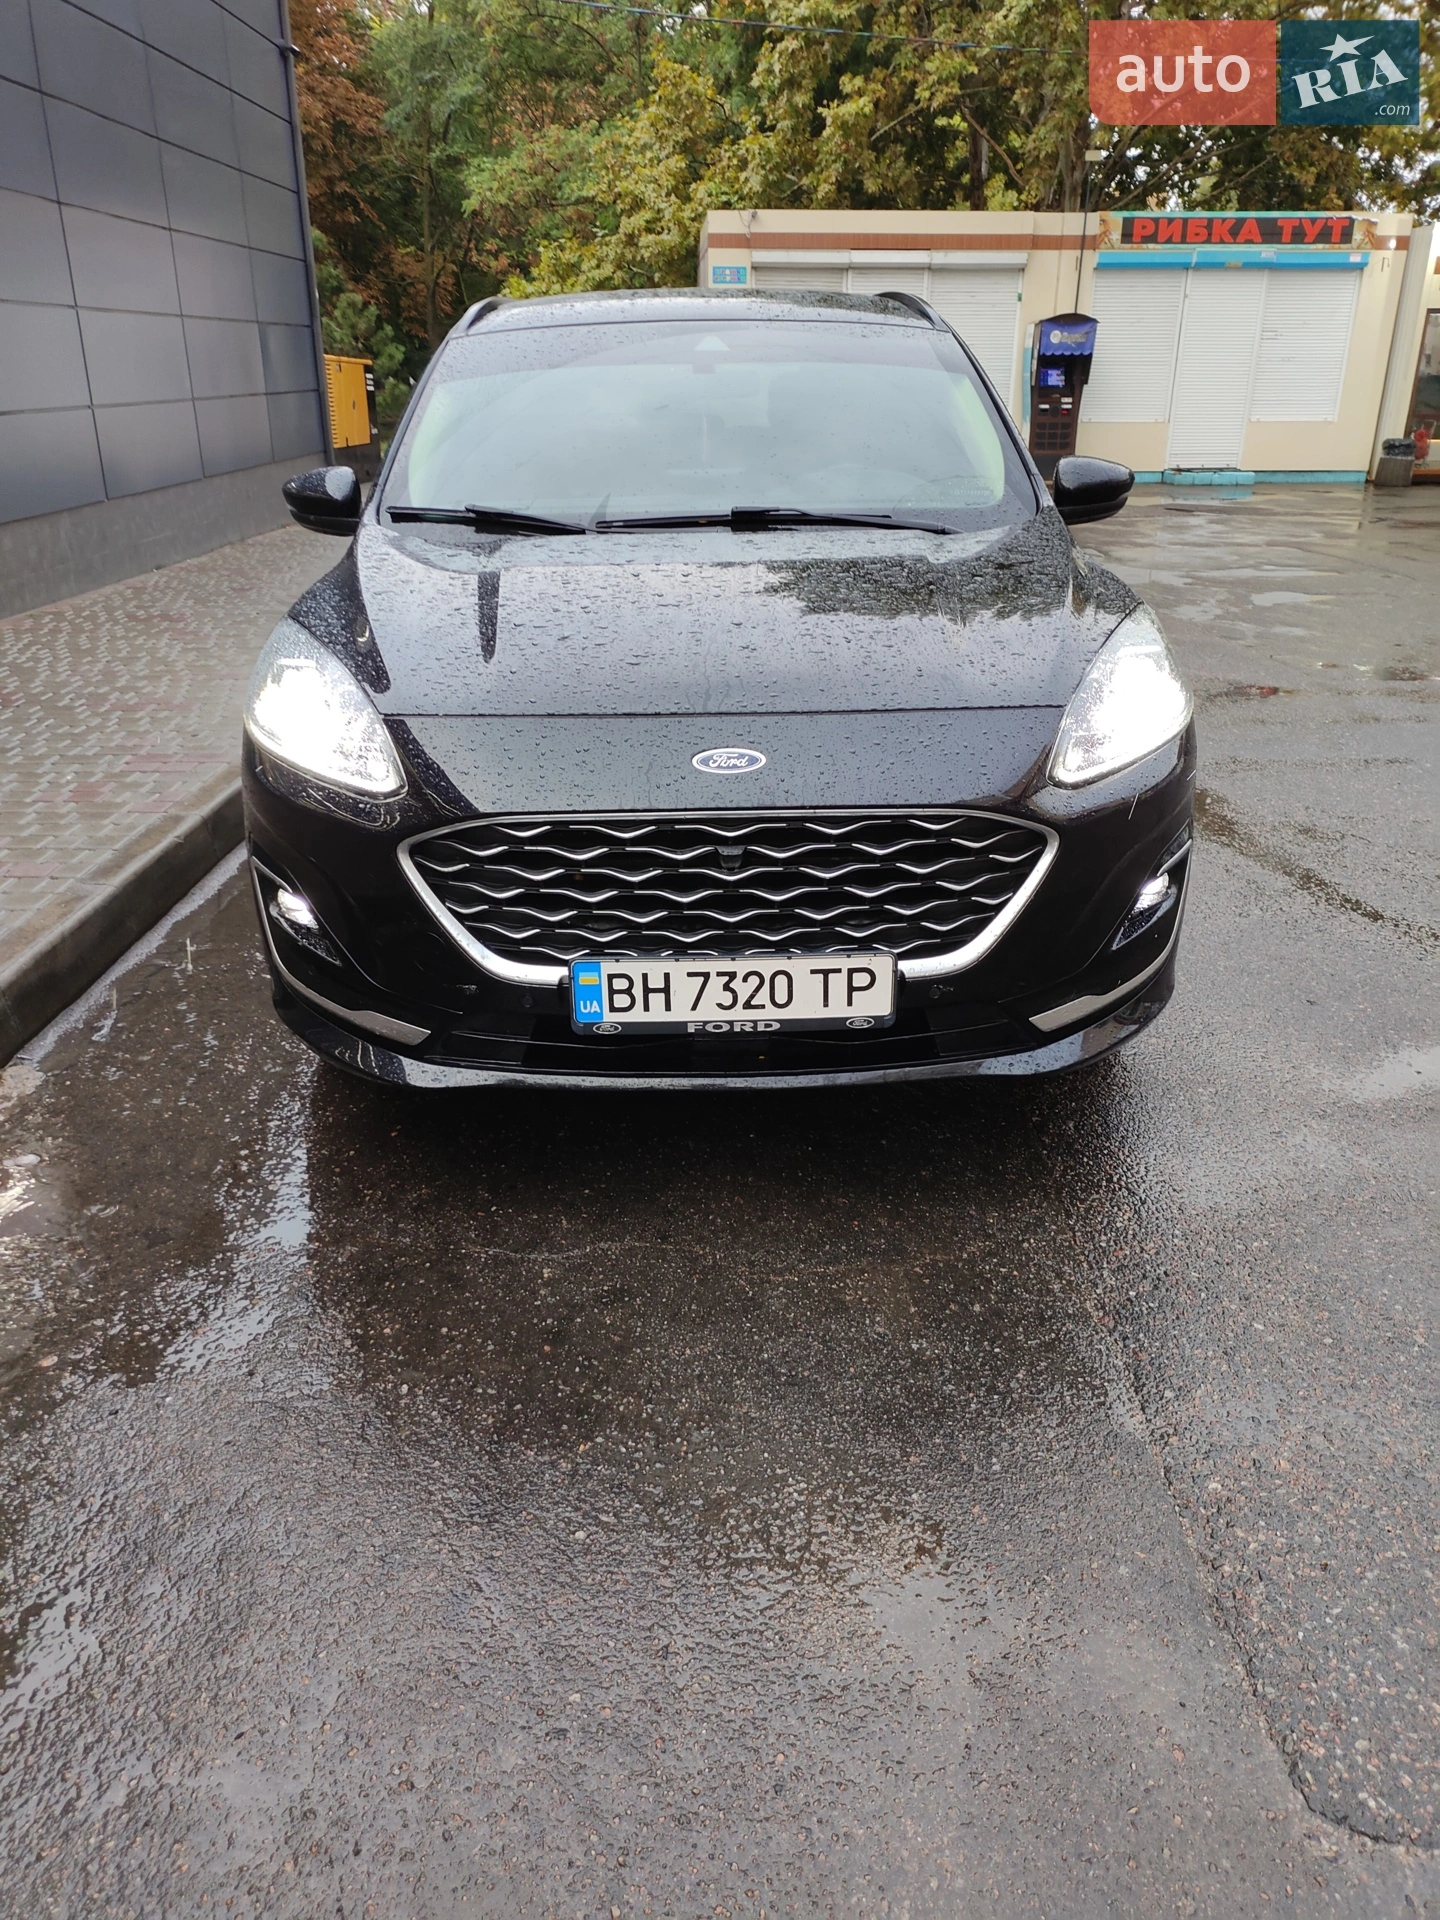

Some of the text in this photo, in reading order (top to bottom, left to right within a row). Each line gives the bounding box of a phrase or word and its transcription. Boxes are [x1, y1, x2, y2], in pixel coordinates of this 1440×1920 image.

[1132, 218, 1350, 243] РИБКА ТУТ
[708, 753, 749, 768] Ford
[606, 967, 877, 1013] BH 7320 TP
[580, 1000, 601, 1013] UA
[687, 1020, 781, 1033] FORD
